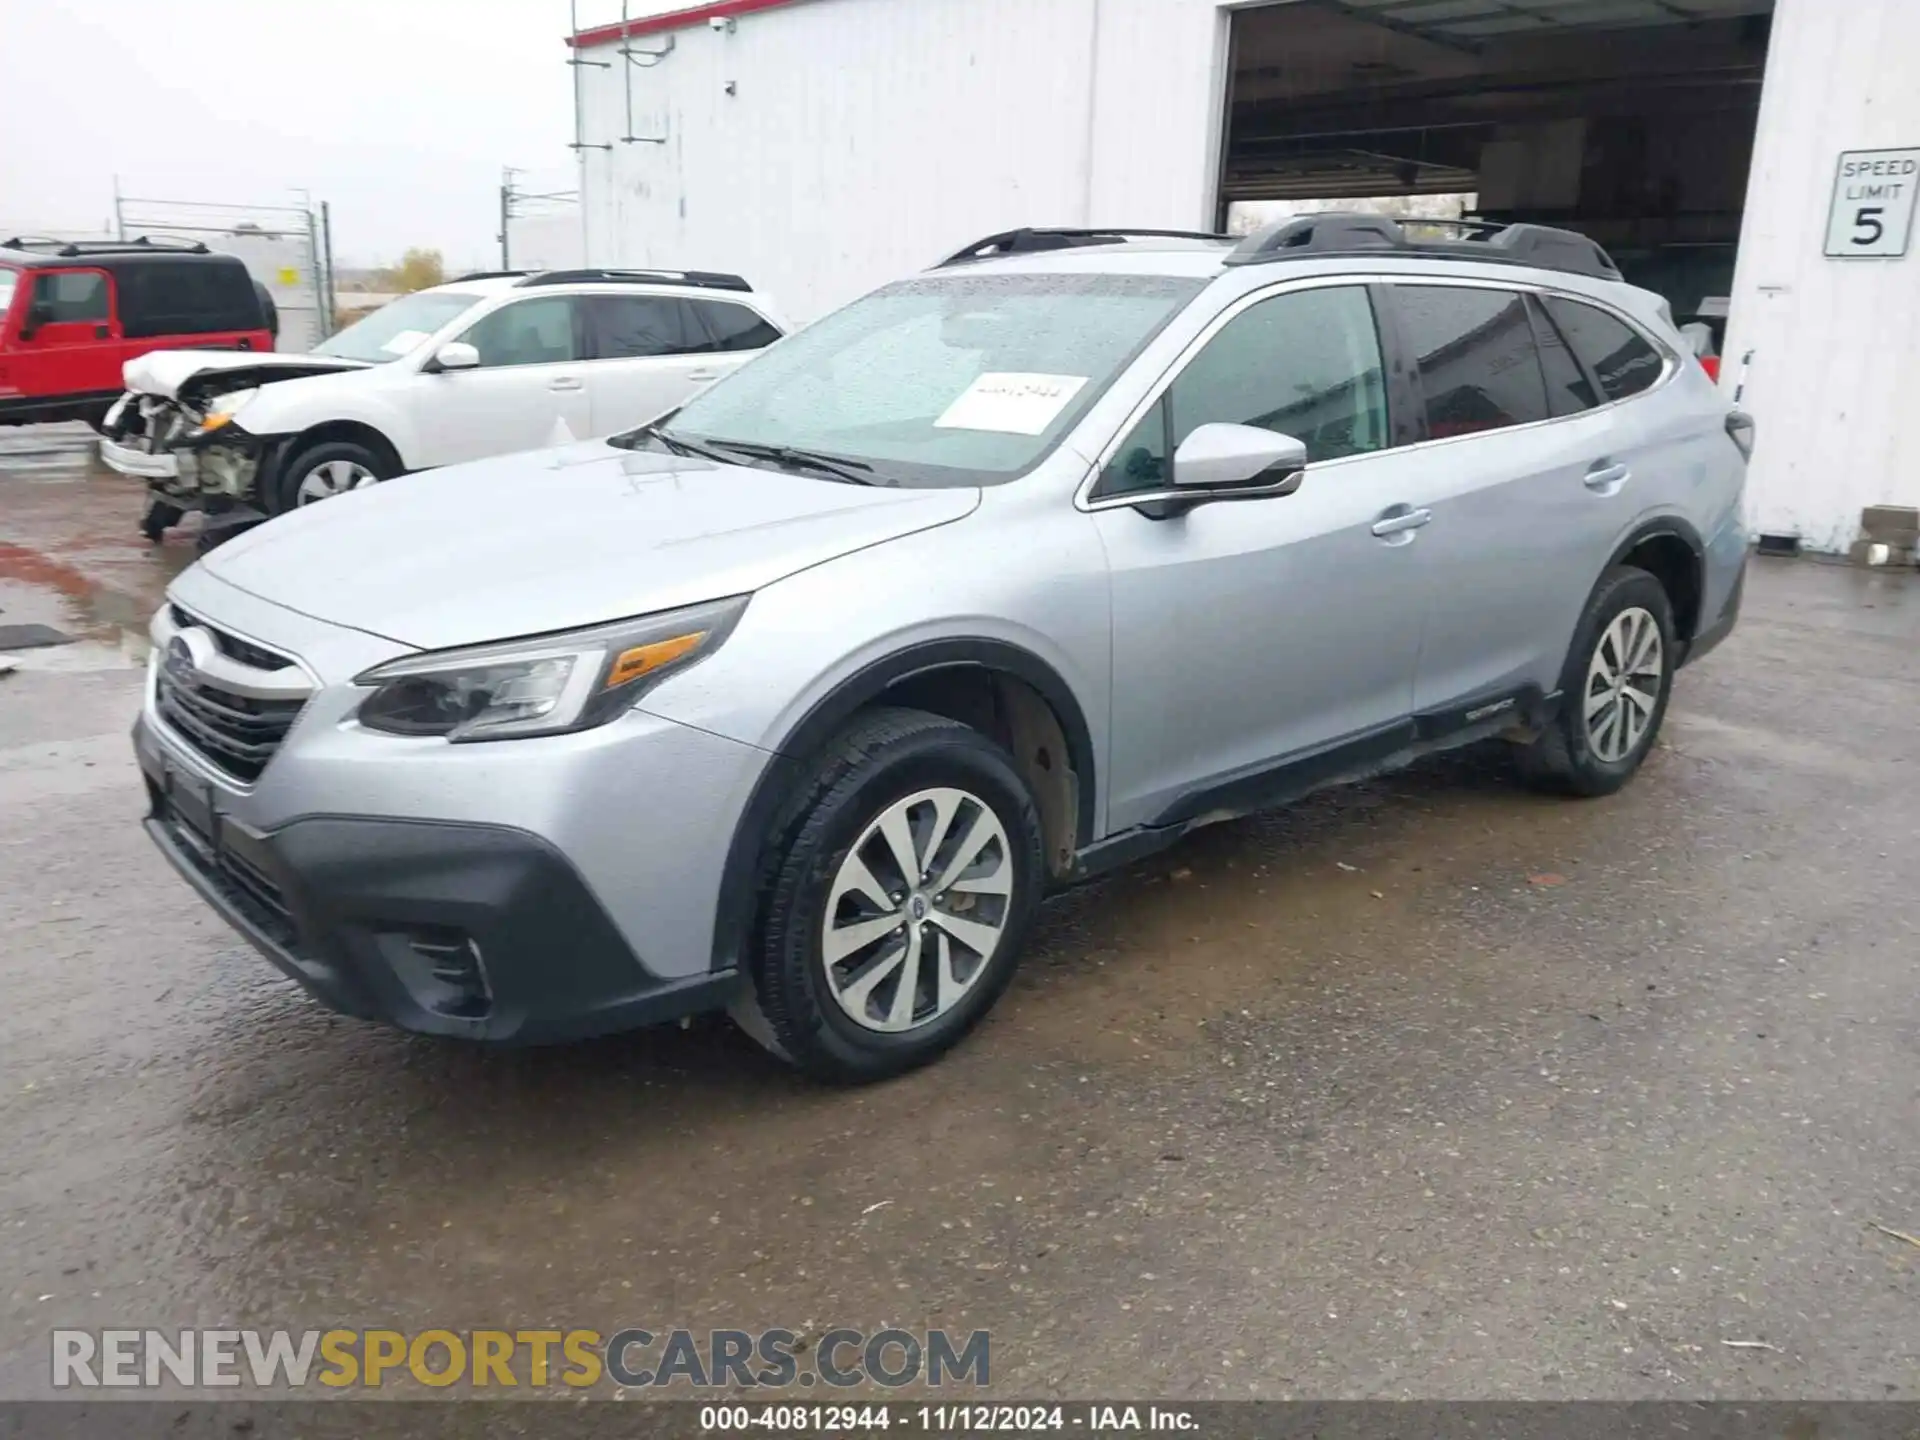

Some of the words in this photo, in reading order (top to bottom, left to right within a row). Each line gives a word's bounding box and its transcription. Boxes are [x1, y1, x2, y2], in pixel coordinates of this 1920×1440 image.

[1842, 159, 1917, 177] SPEED
[1846, 183, 1904, 200] LIMIT
[1849, 206, 1885, 246] 5
